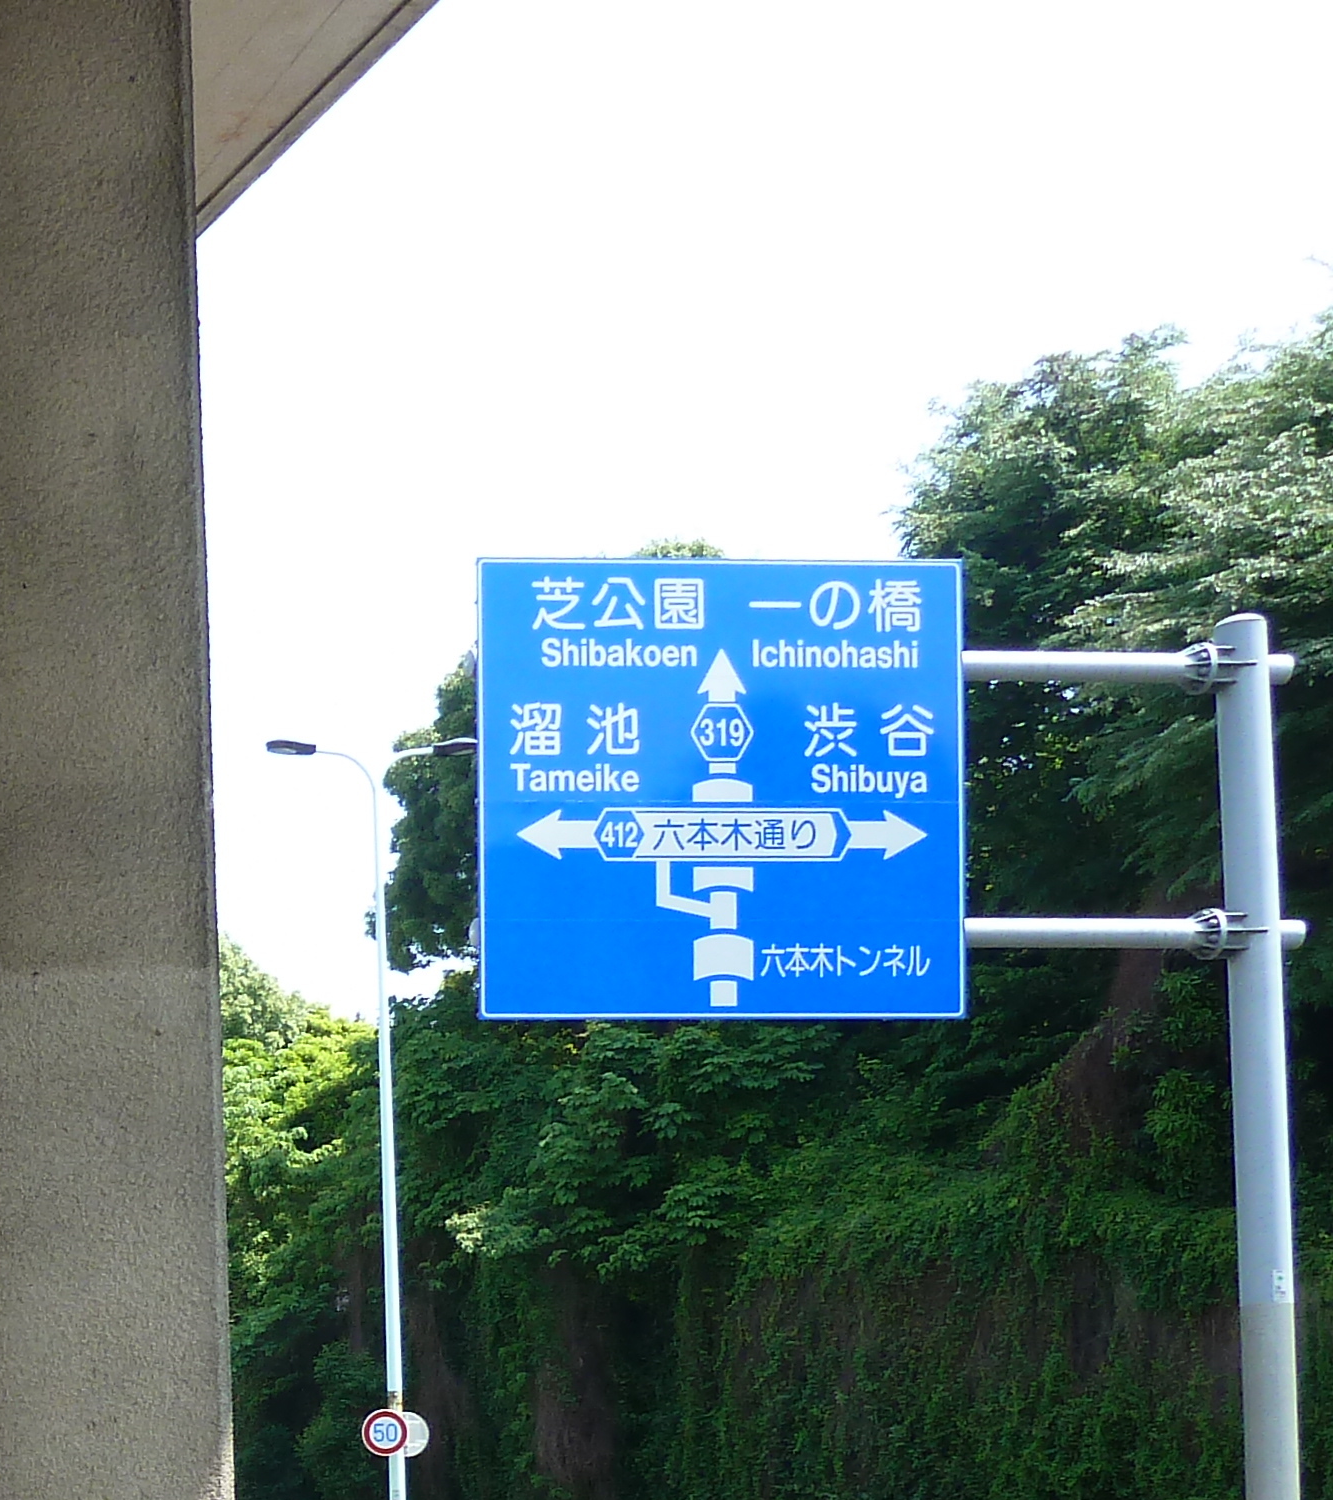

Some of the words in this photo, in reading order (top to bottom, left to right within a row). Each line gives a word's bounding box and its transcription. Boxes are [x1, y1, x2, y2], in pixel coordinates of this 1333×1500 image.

[532, 576, 705, 630] 芝公園
[749, 579, 922, 632] 一の橋
[541, 638, 698, 667] Shibakoen
[752, 639, 919, 668] Ichinohashi
[509, 702, 640, 755] 溜池
[700, 718, 744, 747] 319
[804, 703, 935, 757] 渋谷
[510, 763, 640, 792] Tameike
[811, 764, 928, 799] Shibuya
[600, 821, 639, 848] 412
[653, 818, 817, 851] 六本木通り
[760, 943, 931, 977] 六本木トンネル
[373, 1423, 398, 1442] 50
